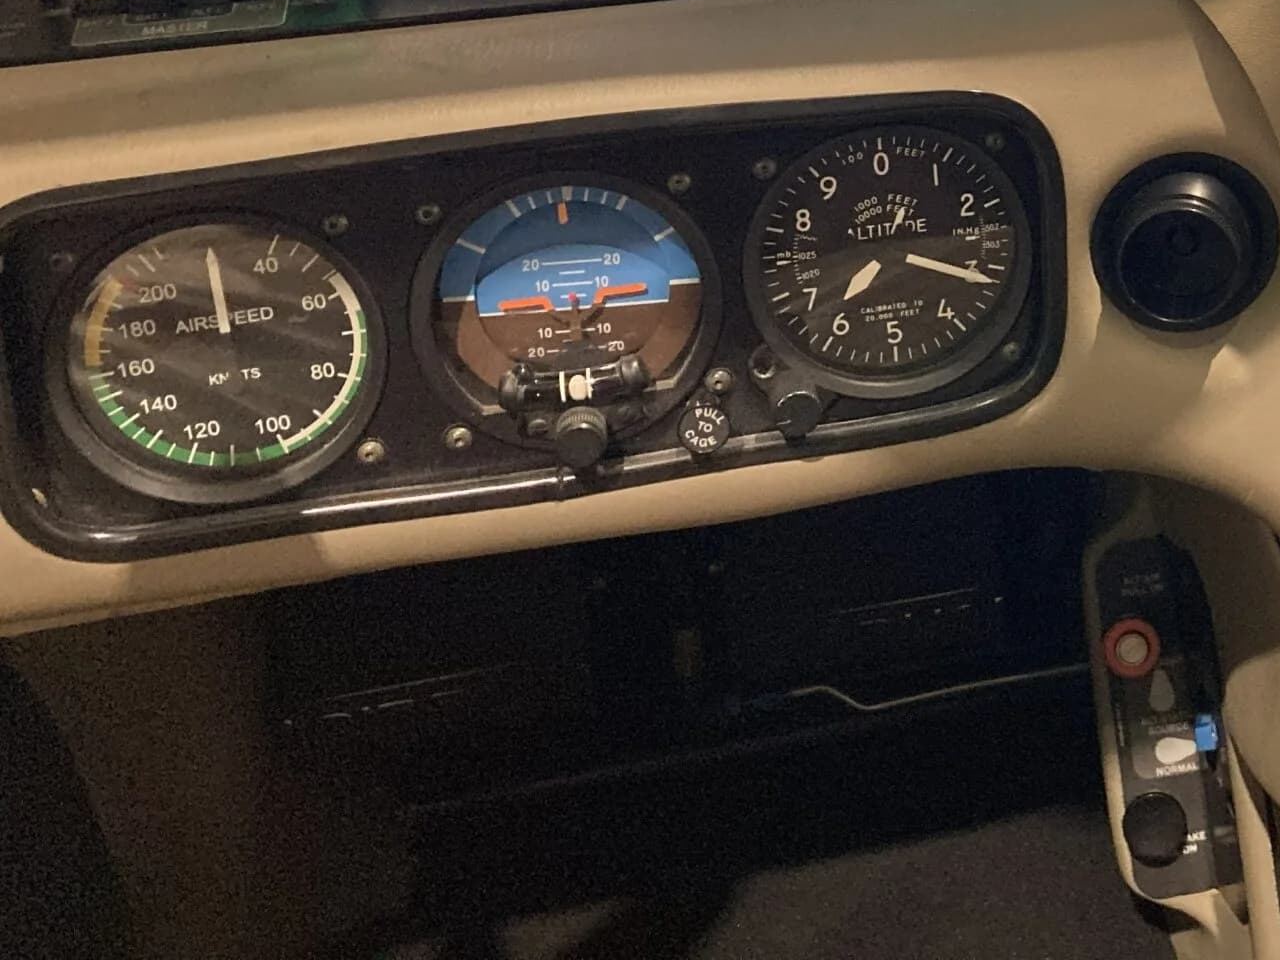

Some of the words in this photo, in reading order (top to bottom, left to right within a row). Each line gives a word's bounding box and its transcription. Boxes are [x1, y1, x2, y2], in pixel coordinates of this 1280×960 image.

[873, 152, 890, 176] 0
[820, 176, 837, 200] 9
[960, 193, 975, 217] 2
[796, 209, 811, 232] 8
[253, 257, 278, 273] 40
[139, 284, 177, 304] 200
[302, 294, 326, 311] 60
[119, 319, 156, 339] 180
[887, 321, 903, 343] 5
[117, 358, 155, 378] 160
[311, 362, 335, 379] 80
[140, 394, 178, 414] 140
[255, 415, 291, 434] 100
[695, 407, 725, 425] PULL
[184, 420, 220, 440] 120
[699, 421, 713, 433] TO
[685, 429, 717, 447] CAGE
[1156, 762, 1198, 776] NORMAL
